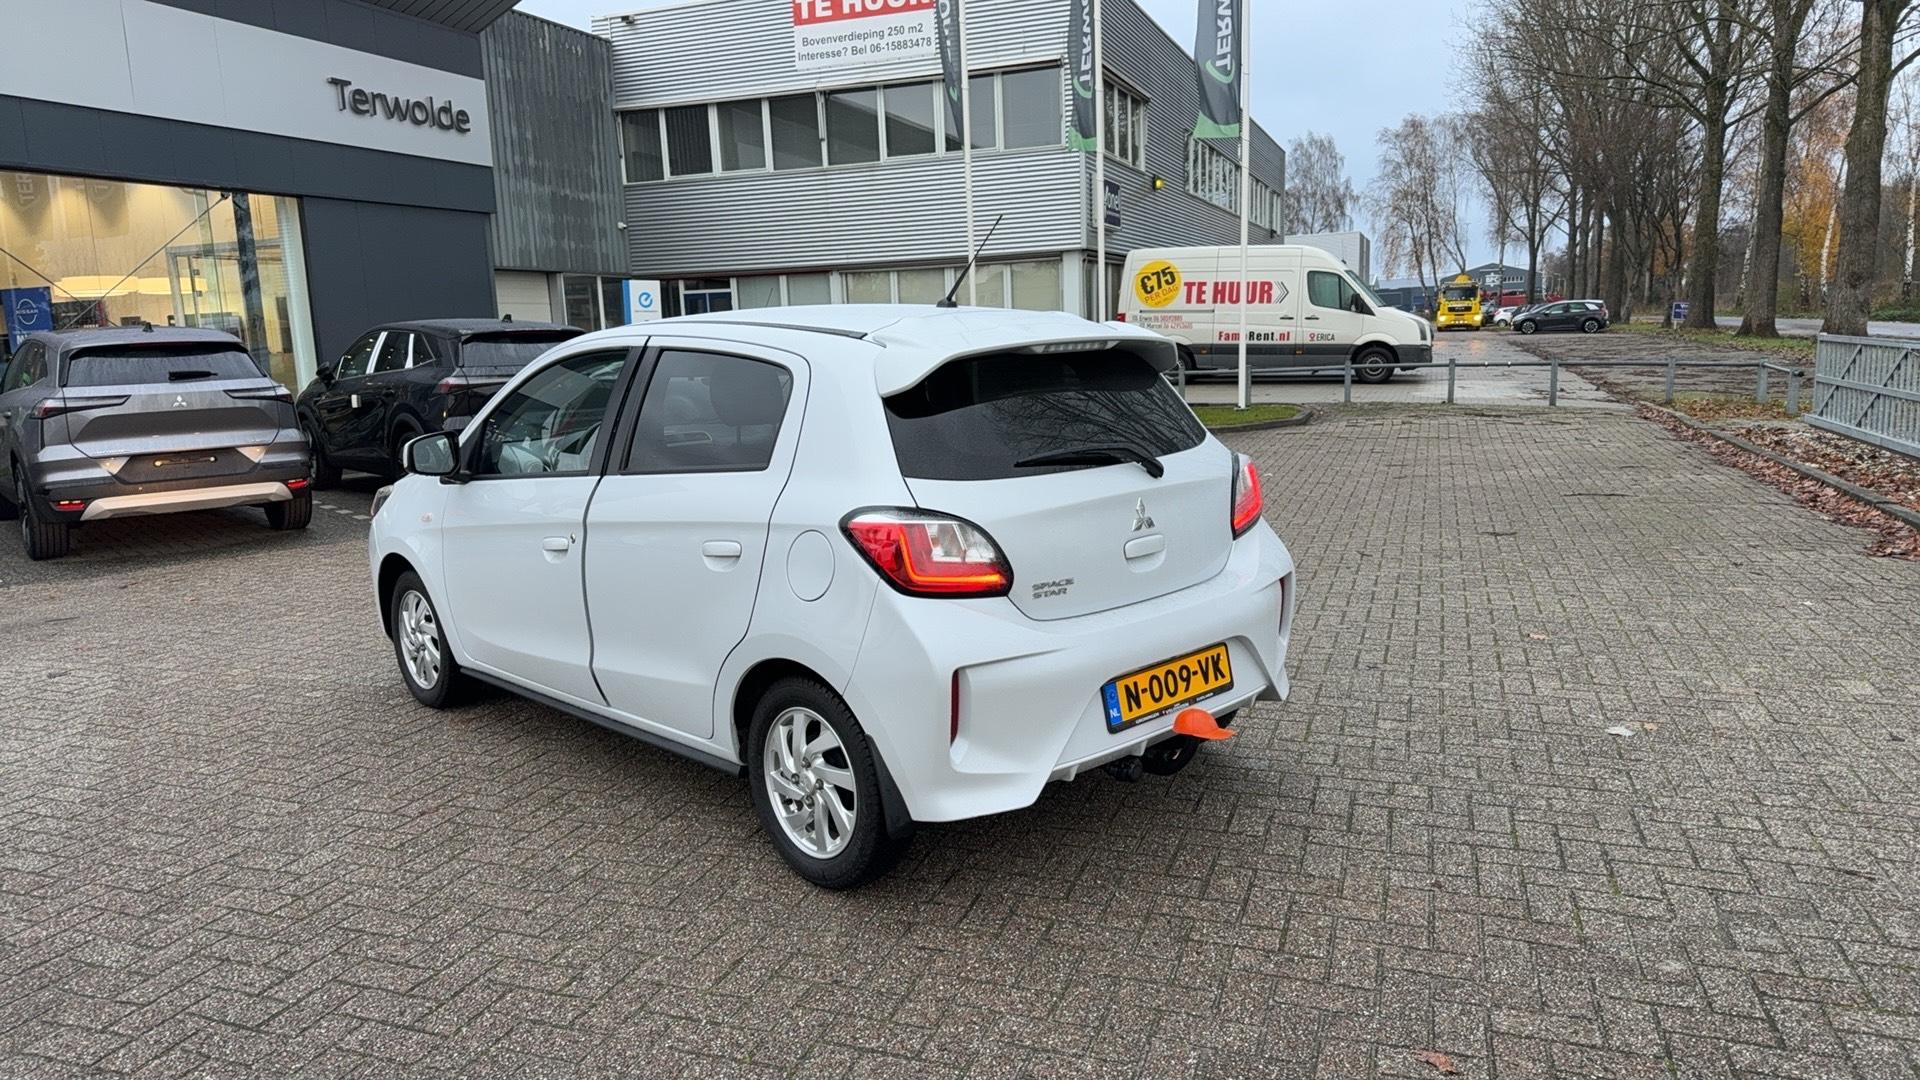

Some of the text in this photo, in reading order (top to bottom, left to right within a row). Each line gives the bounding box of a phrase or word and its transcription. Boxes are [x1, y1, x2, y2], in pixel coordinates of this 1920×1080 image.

[802, 23, 924, 47] Bovenverdieping 250 m2
[798, 37, 932, 61] Interesse? Bel 06-15883478
[326, 77, 471, 133] Terwolde
[1140, 266, 1176, 295] €75
[1184, 281, 1273, 304] TE HUUR
[1218, 331, 1290, 342] FamRent.nl
[1316, 333, 1335, 341] ERICA
[1032, 579, 1074, 590] SPACE
[1032, 588, 1067, 599] STAR
[1124, 652, 1226, 713] N-009-VK
[1110, 708, 1121, 718] NL
